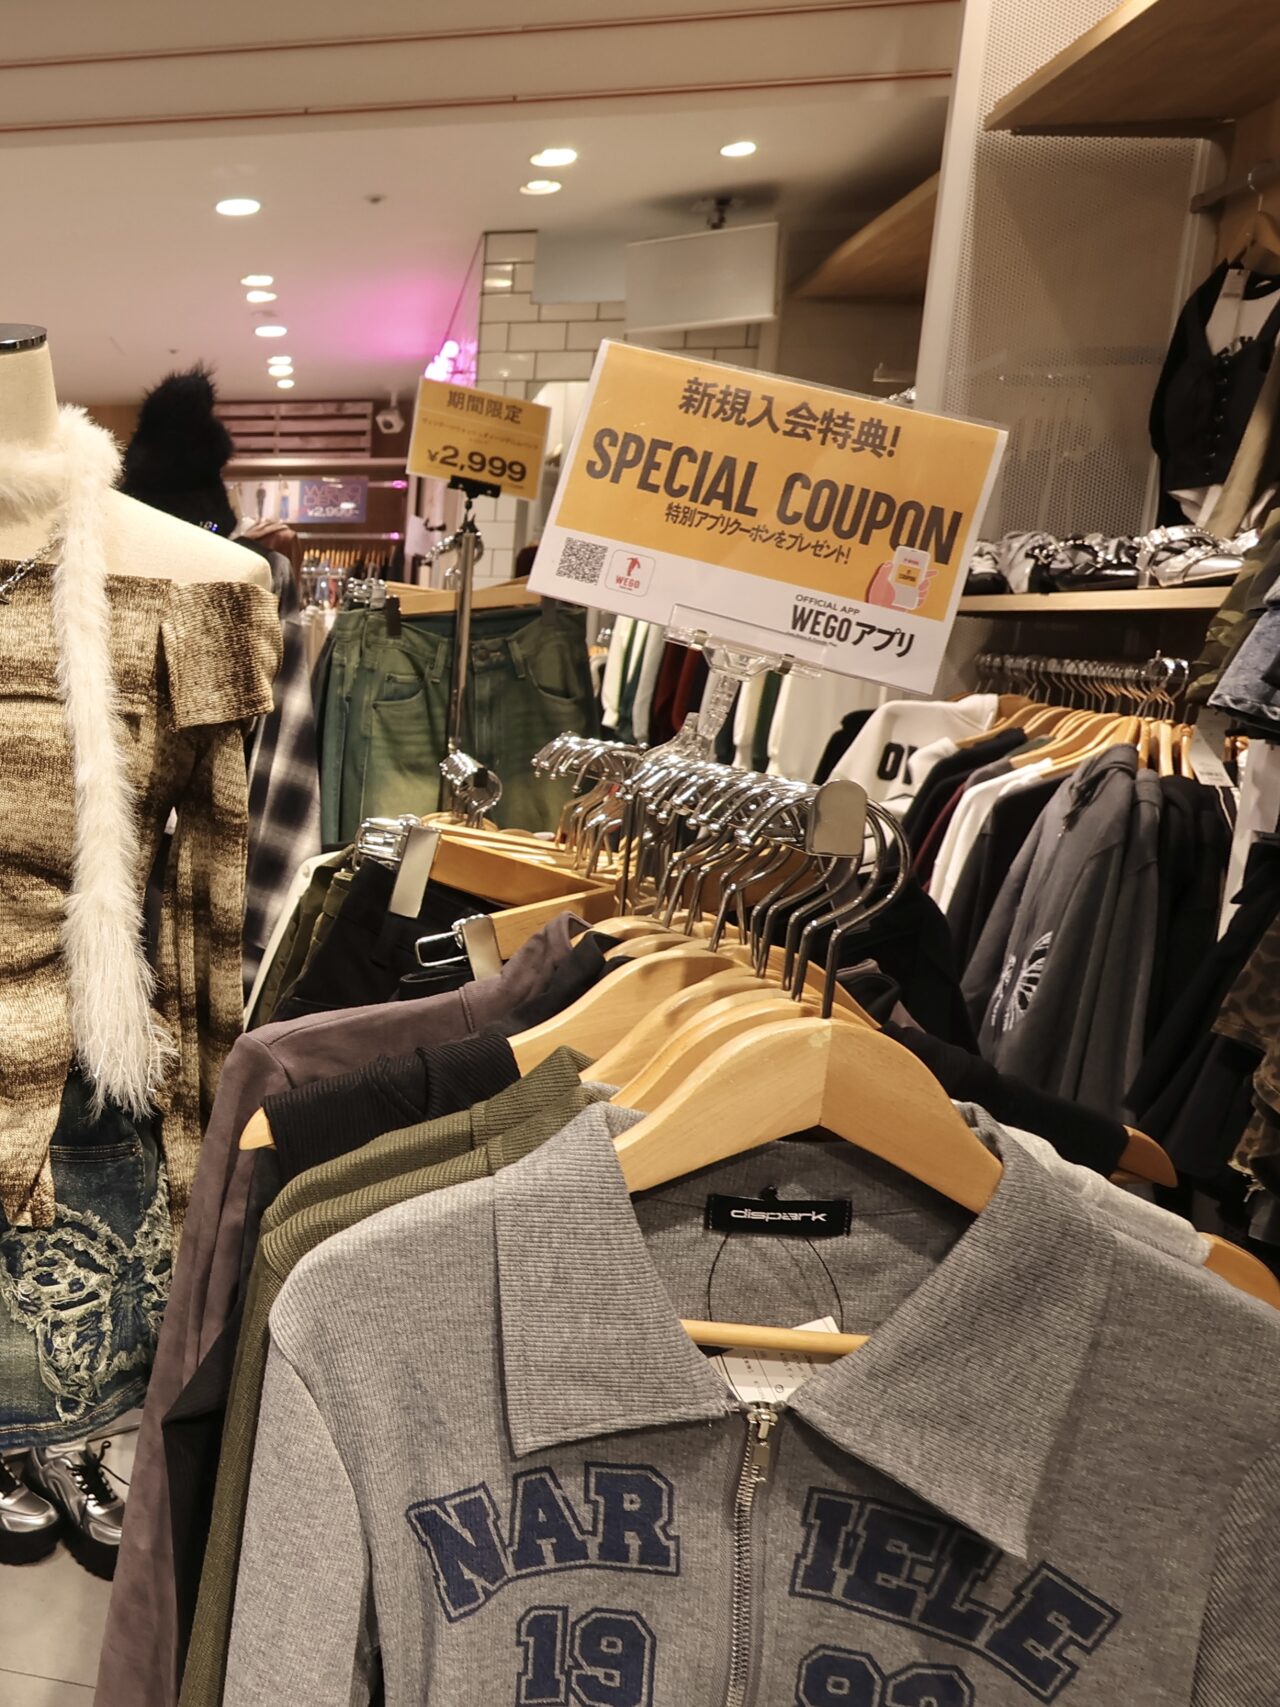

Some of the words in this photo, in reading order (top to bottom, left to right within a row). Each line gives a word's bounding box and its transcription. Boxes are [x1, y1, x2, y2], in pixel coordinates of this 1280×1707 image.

[446, 390, 523, 425] 期間限定
[677, 377, 901, 458] 新規入会特典!
[427, 445, 527, 482] ¥2,999
[586, 427, 758, 517] SPECIAL
[776, 472, 963, 565] COUPON
[664, 501, 852, 565] 特別アプリクーポンをプレゼント!
[615, 575, 640, 589] WEGO
[795, 594, 838, 611] OFFICIAL
[840, 606, 860, 616] APP
[791, 604, 915, 658] WEGOアプリ
[730, 1208, 828, 1222] dispark
[406, 1460, 681, 1623] NAR
[516, 1604, 657, 1707] 19
